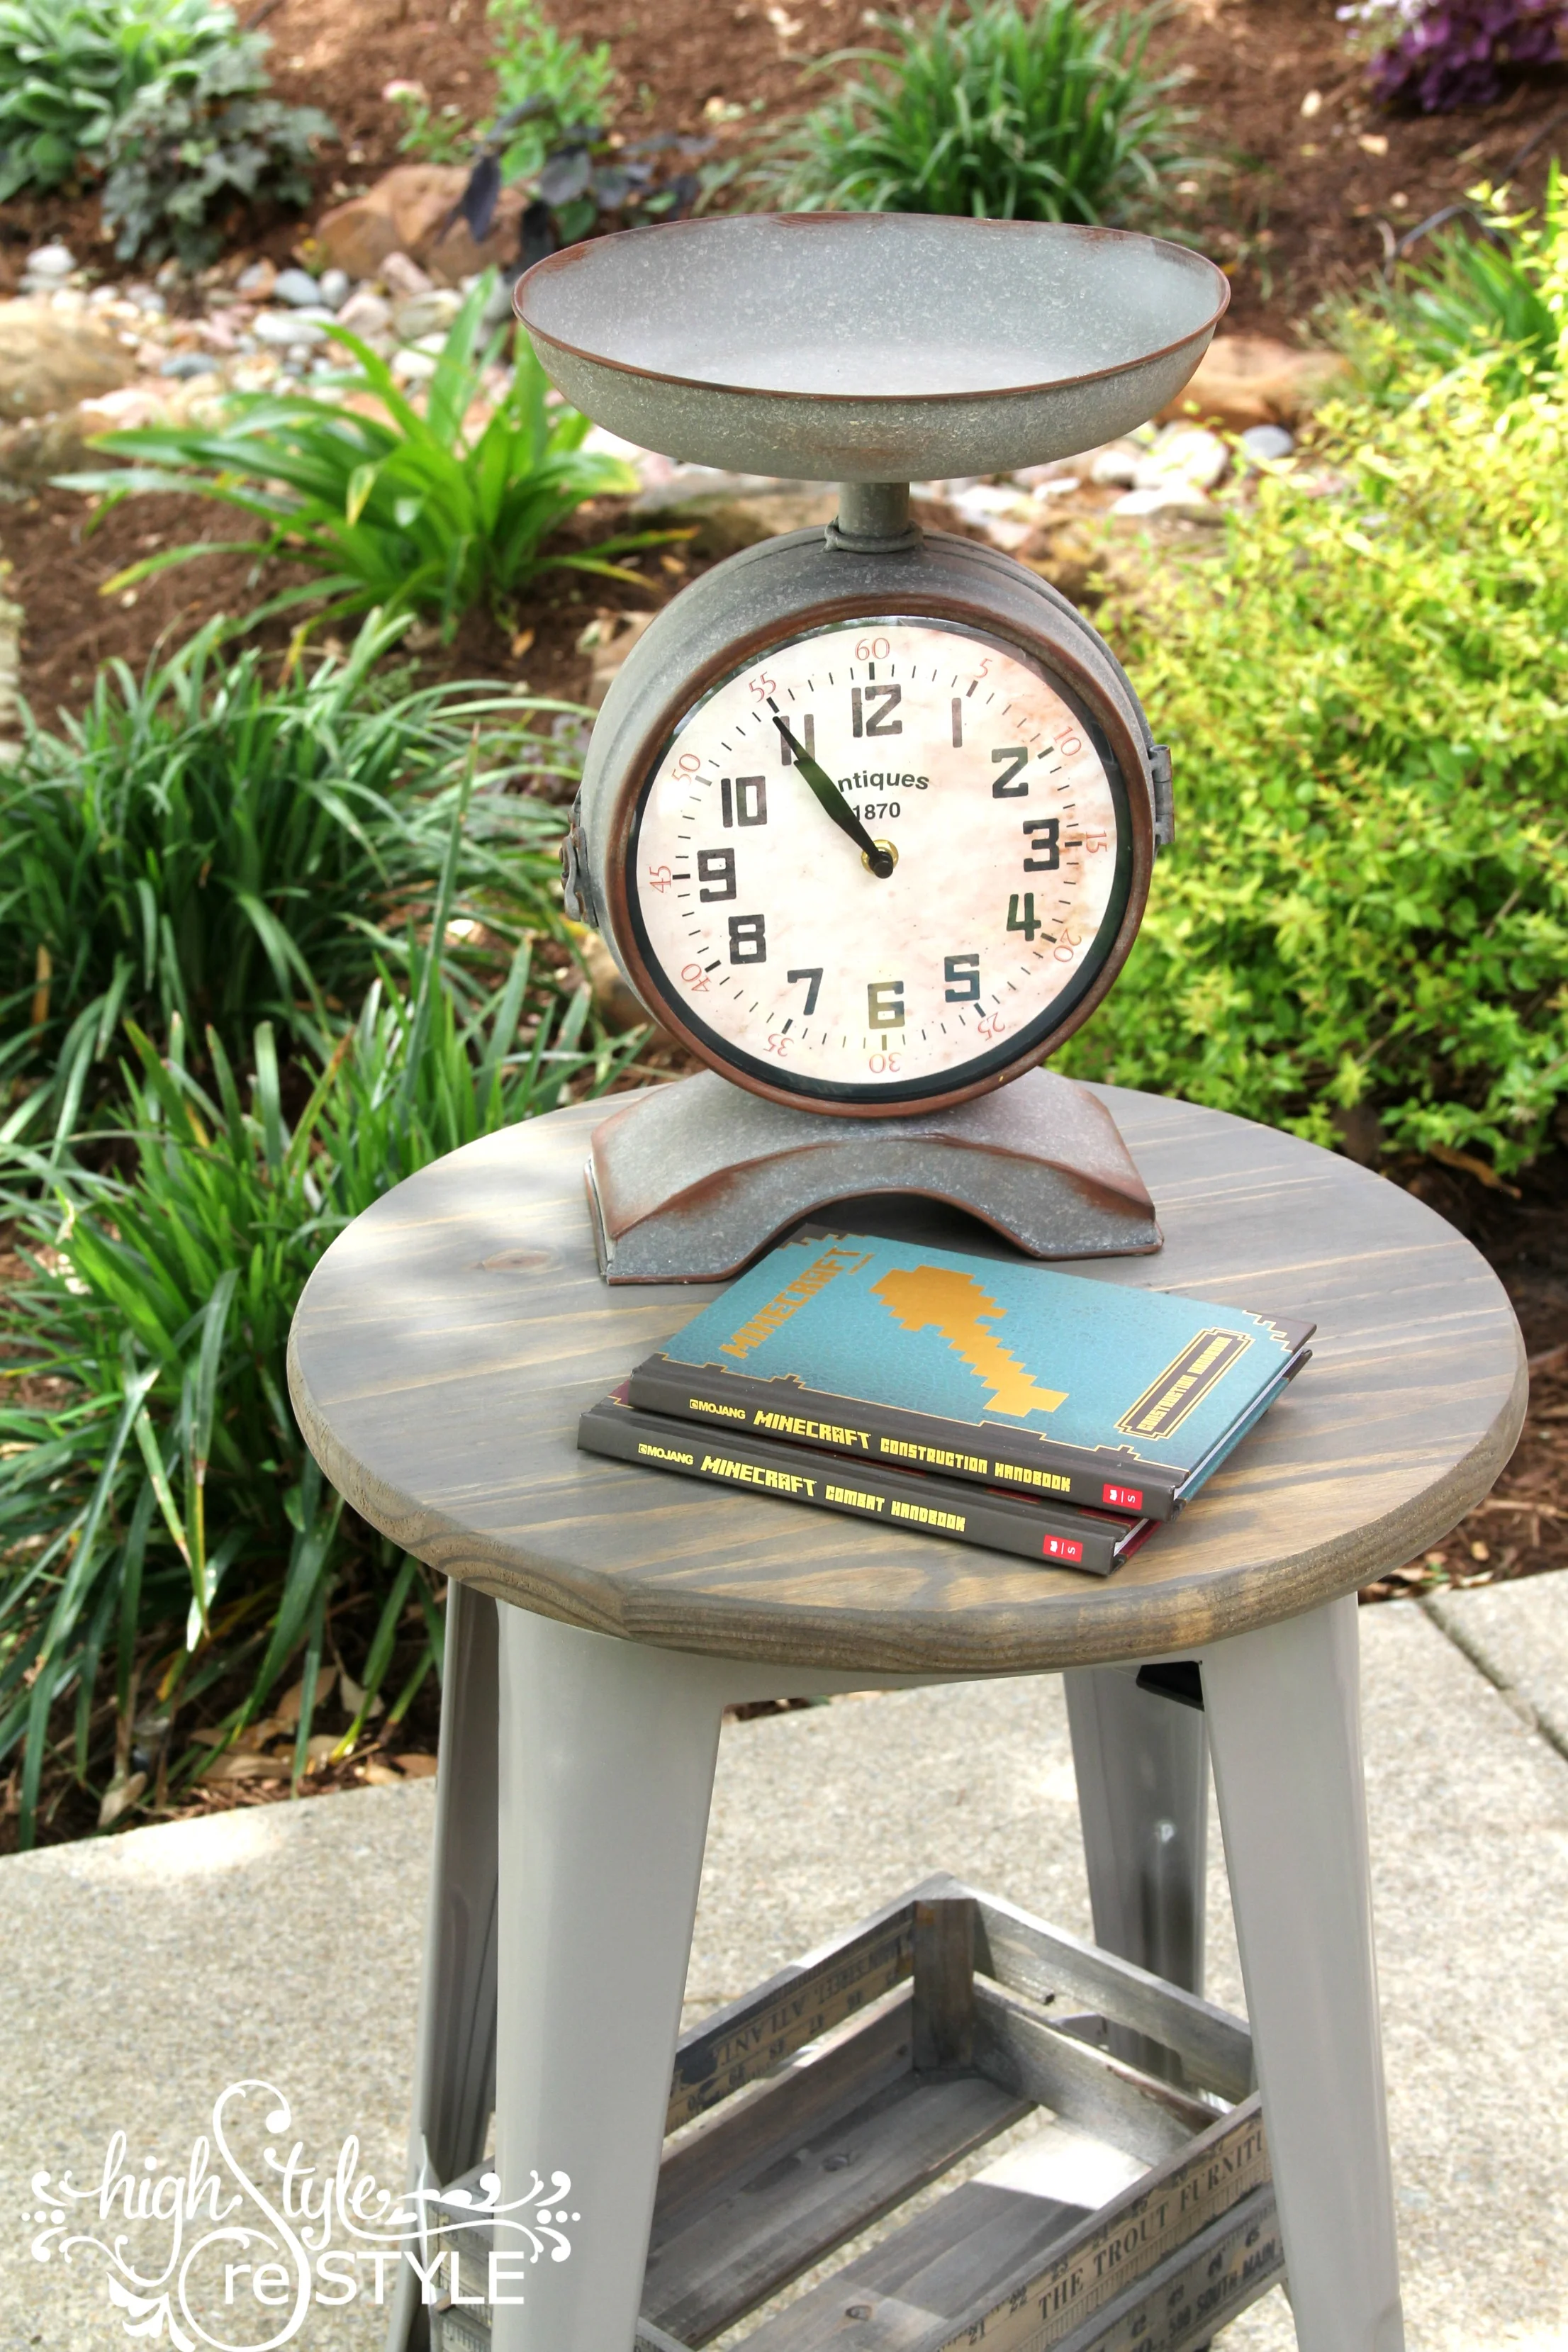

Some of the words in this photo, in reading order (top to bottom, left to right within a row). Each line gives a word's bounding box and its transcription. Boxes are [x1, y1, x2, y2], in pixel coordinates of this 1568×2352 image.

[855, 637, 890, 661] 60
[974, 657, 993, 678] 5
[749, 671, 777, 702] 55
[851, 683, 902, 738] 12
[951, 697, 963, 748] 1
[1052, 725, 1082, 756] 10
[671, 753, 701, 785] 50
[837, 770, 930, 793] ntiques
[991, 746, 1029, 799] 2
[720, 775, 768, 828] 10
[852, 802, 901, 822] 1870
[1022, 817, 1060, 872] 3
[1085, 830, 1107, 853] 15
[649, 866, 671, 893] 45
[697, 847, 737, 903] 9
[728, 914, 767, 965] 8
[1006, 892, 1041, 941] 4
[1053, 928, 1082, 963] 20
[681, 963, 712, 992] 40
[787, 967, 824, 1016] 7
[944, 953, 980, 1003] 5
[867, 980, 905, 1029] 6
[977, 1012, 1005, 1041] 25
[763, 1033, 794, 1057] 35
[869, 1052, 902, 1073] 30
[719, 1245, 862, 1360] MINECRAFT
[1136, 1374, 1199, 1432] CONSTRUCTION
[1187, 1336, 1233, 1375] HANDBOOK
[698, 1401, 746, 1420] MOJANG
[754, 1410, 871, 1450] MINECRAFT
[880, 1437, 988, 1474] CONSTRUCTION
[995, 1462, 1071, 1492] HANDBOOK
[646, 1445, 694, 1465] MOJANG
[700, 1455, 817, 1497] MINECRAFT
[825, 1484, 885, 1513] COMBAT
[891, 1500, 966, 1533] HANDBOOK
[1039, 2268, 1084, 2319] THE
[1093, 2200, 1170, 2278] TROUT
